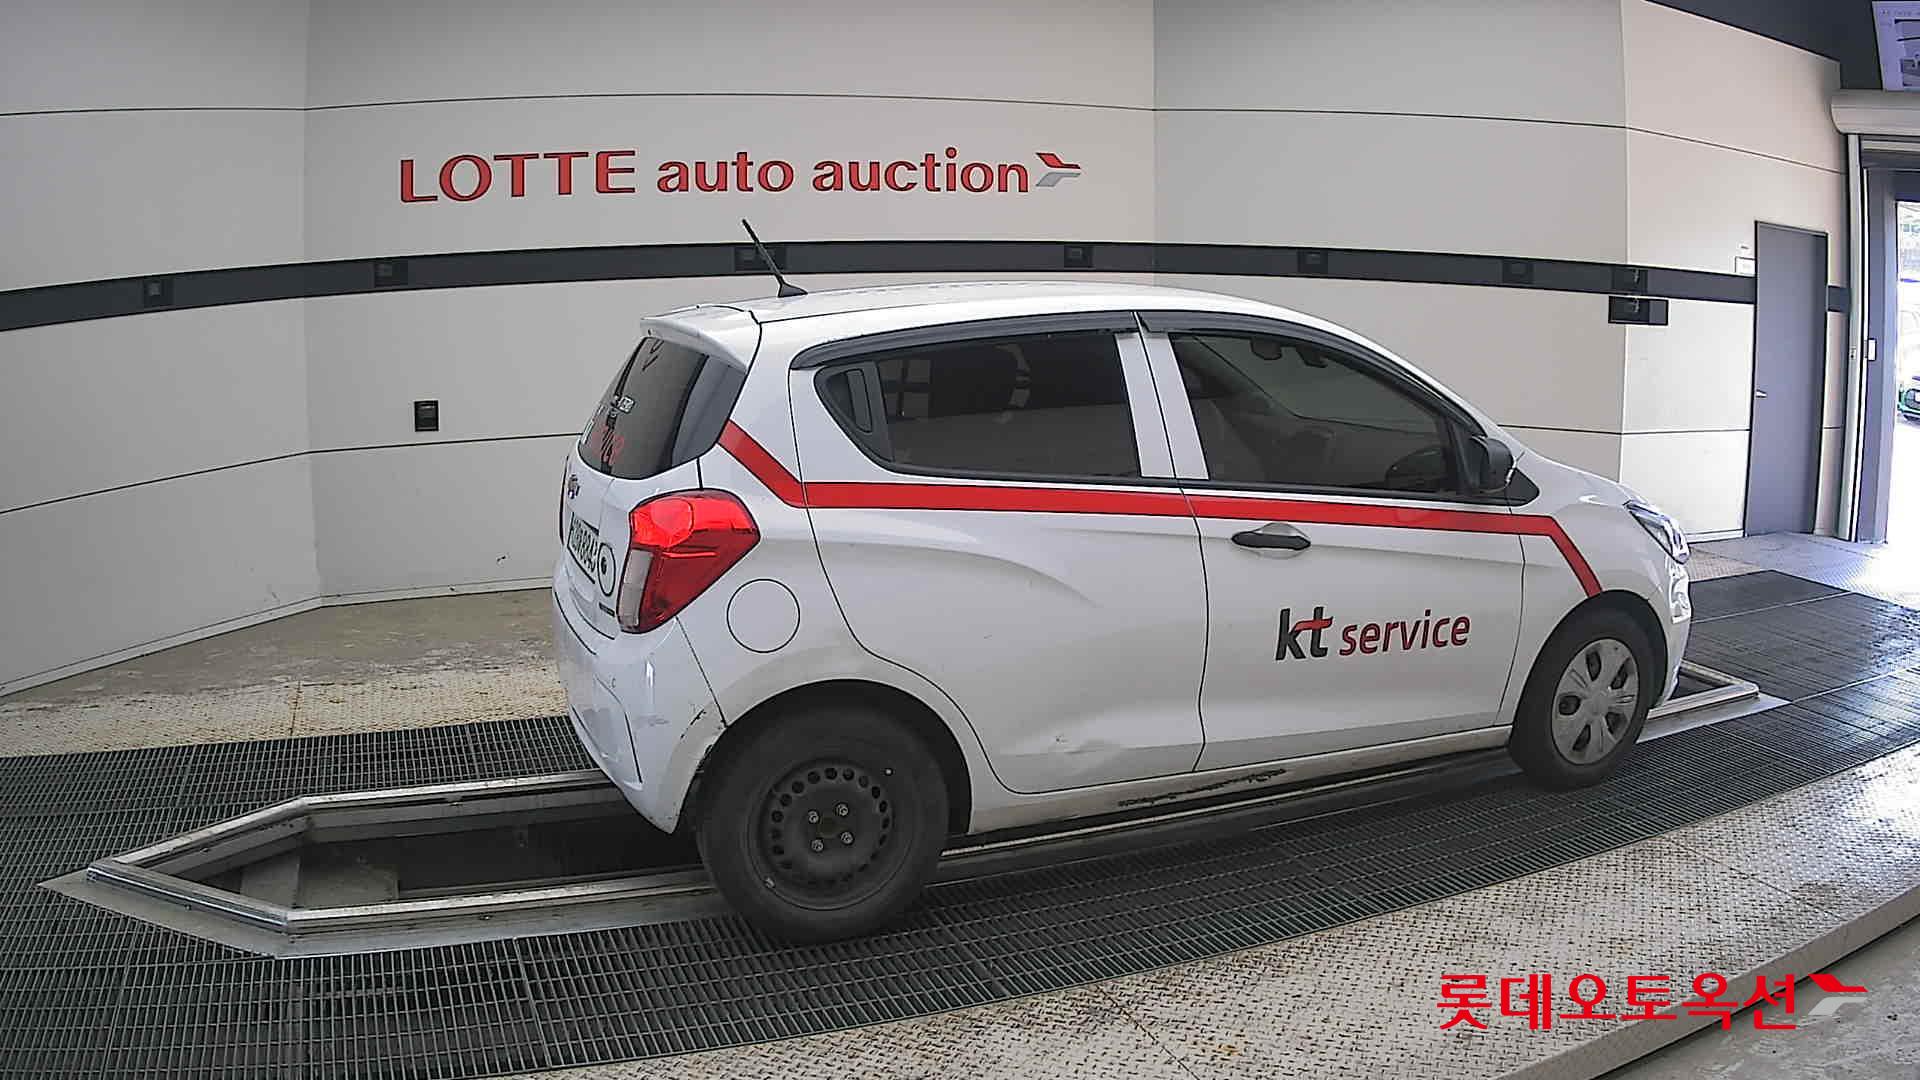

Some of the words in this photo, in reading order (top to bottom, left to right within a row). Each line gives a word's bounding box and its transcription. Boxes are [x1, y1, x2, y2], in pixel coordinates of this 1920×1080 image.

[400, 150, 636, 203] LOTTE
[657, 152, 794, 193] auto
[812, 147, 1030, 194] auction
[1275, 606, 1333, 661] kt
[1339, 609, 1471, 656] service
